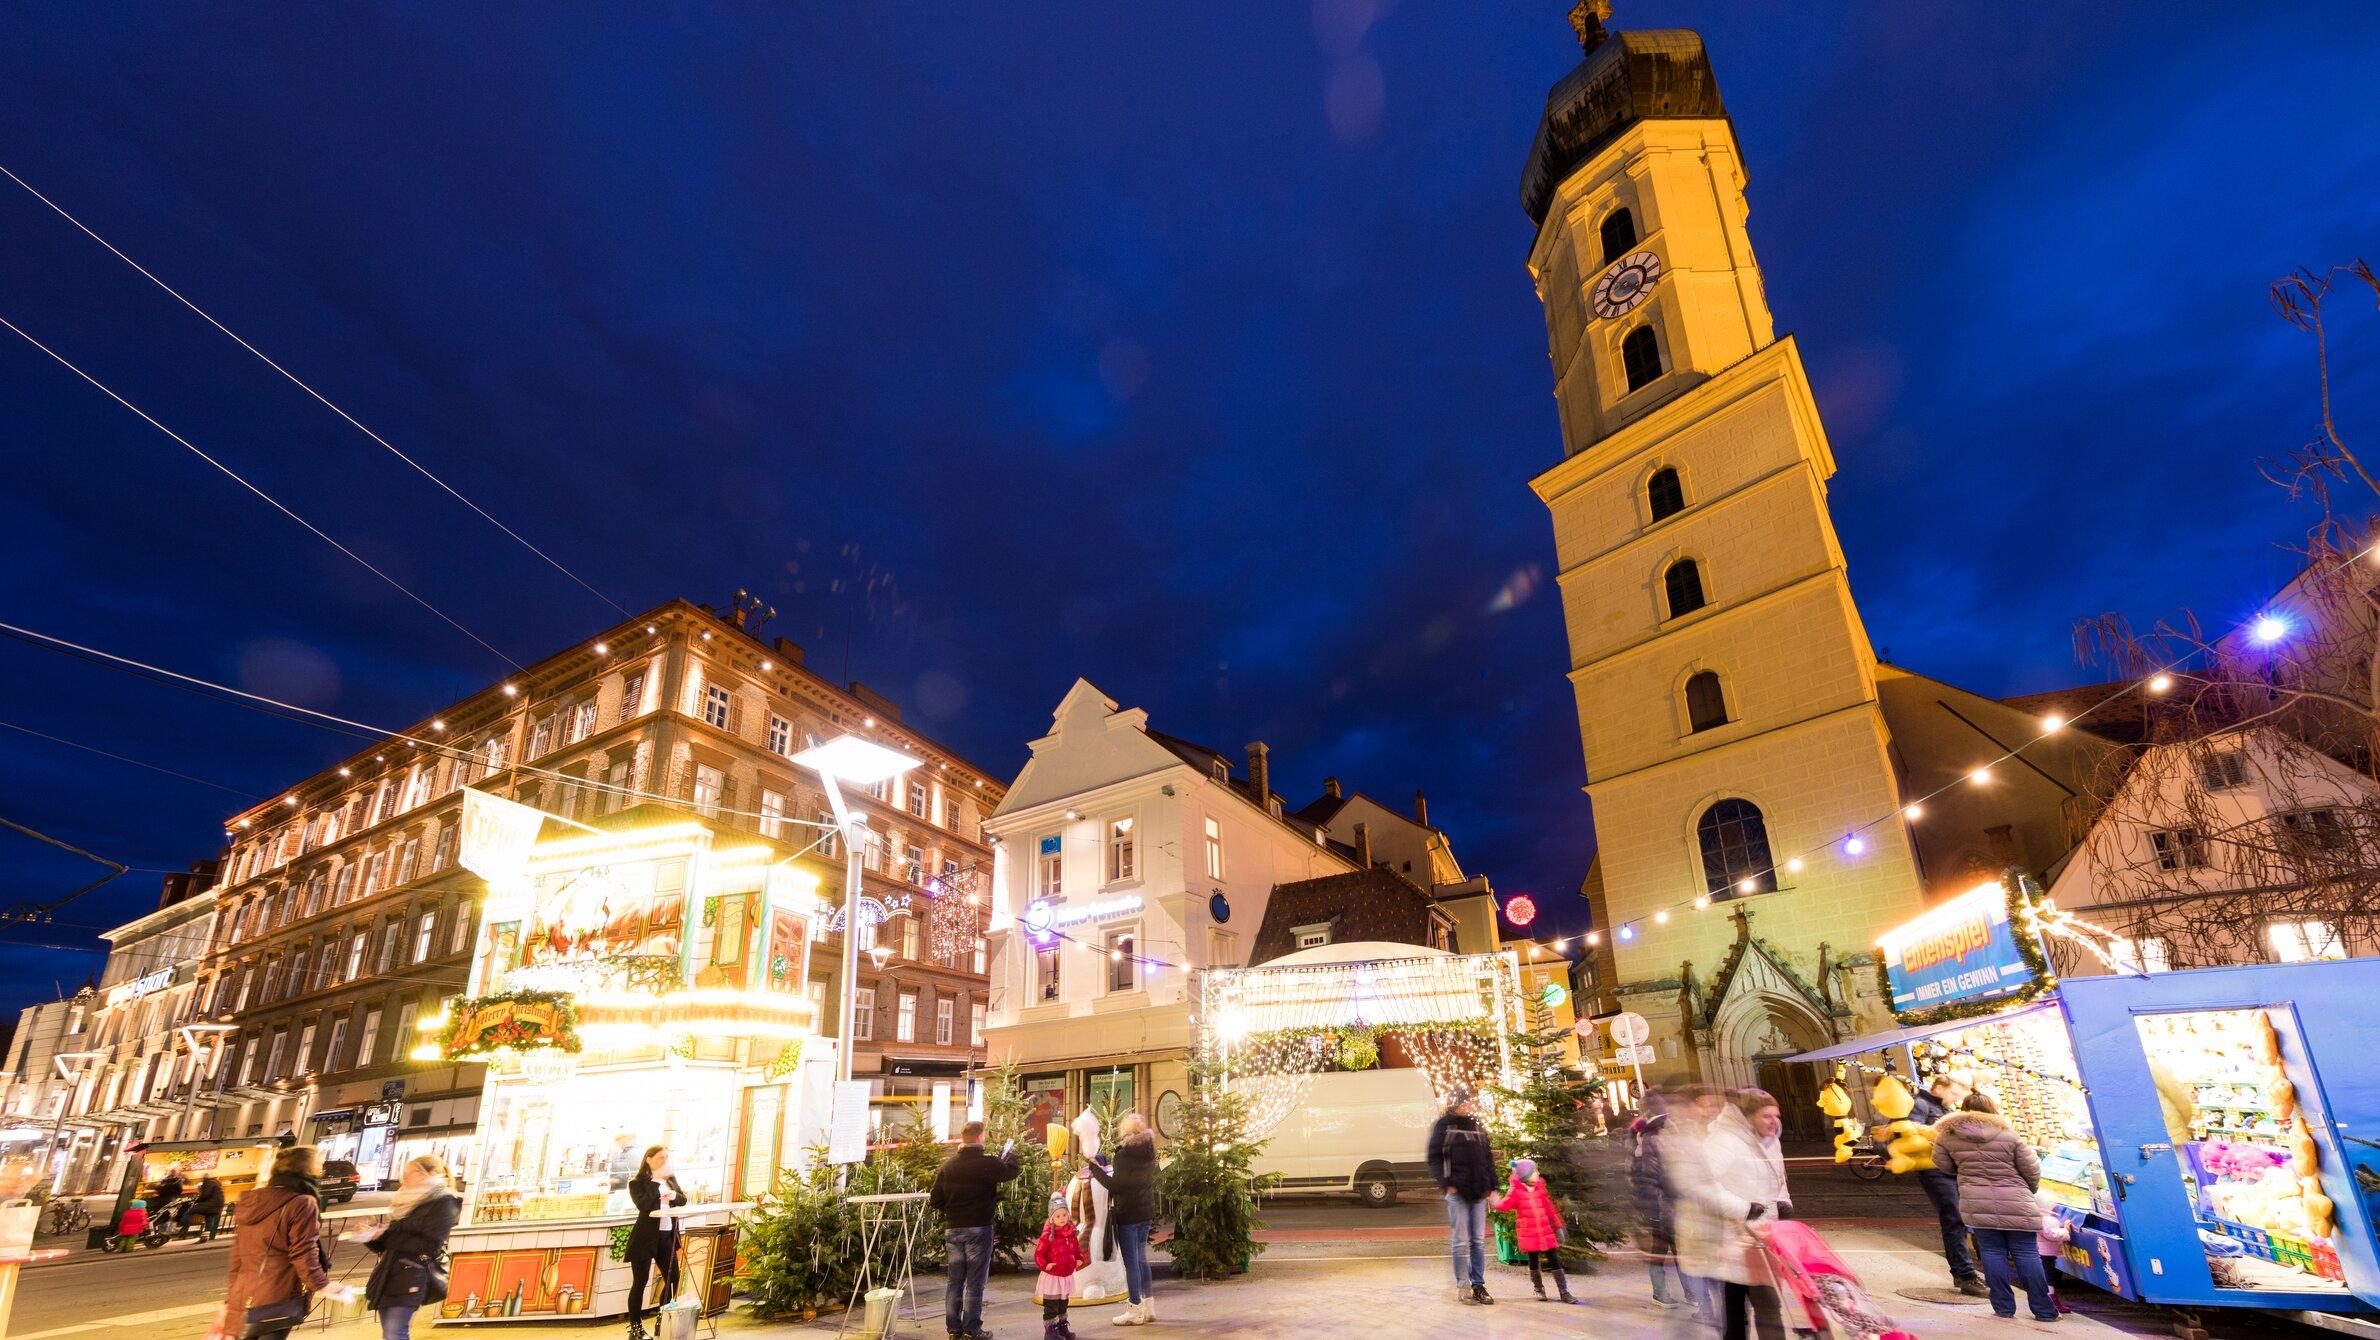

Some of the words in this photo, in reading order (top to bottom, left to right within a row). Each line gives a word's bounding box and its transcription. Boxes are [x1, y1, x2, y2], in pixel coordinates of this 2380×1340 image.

[1903, 911, 1991, 973] Entenspiel
[1915, 981, 1943, 1001] IMMER
[1941, 977, 1959, 995] EIN
[1957, 965, 1998, 990] GEWINN
[508, 1002, 552, 1021] Christmas
[381, 1129, 395, 1168] OPTIK
